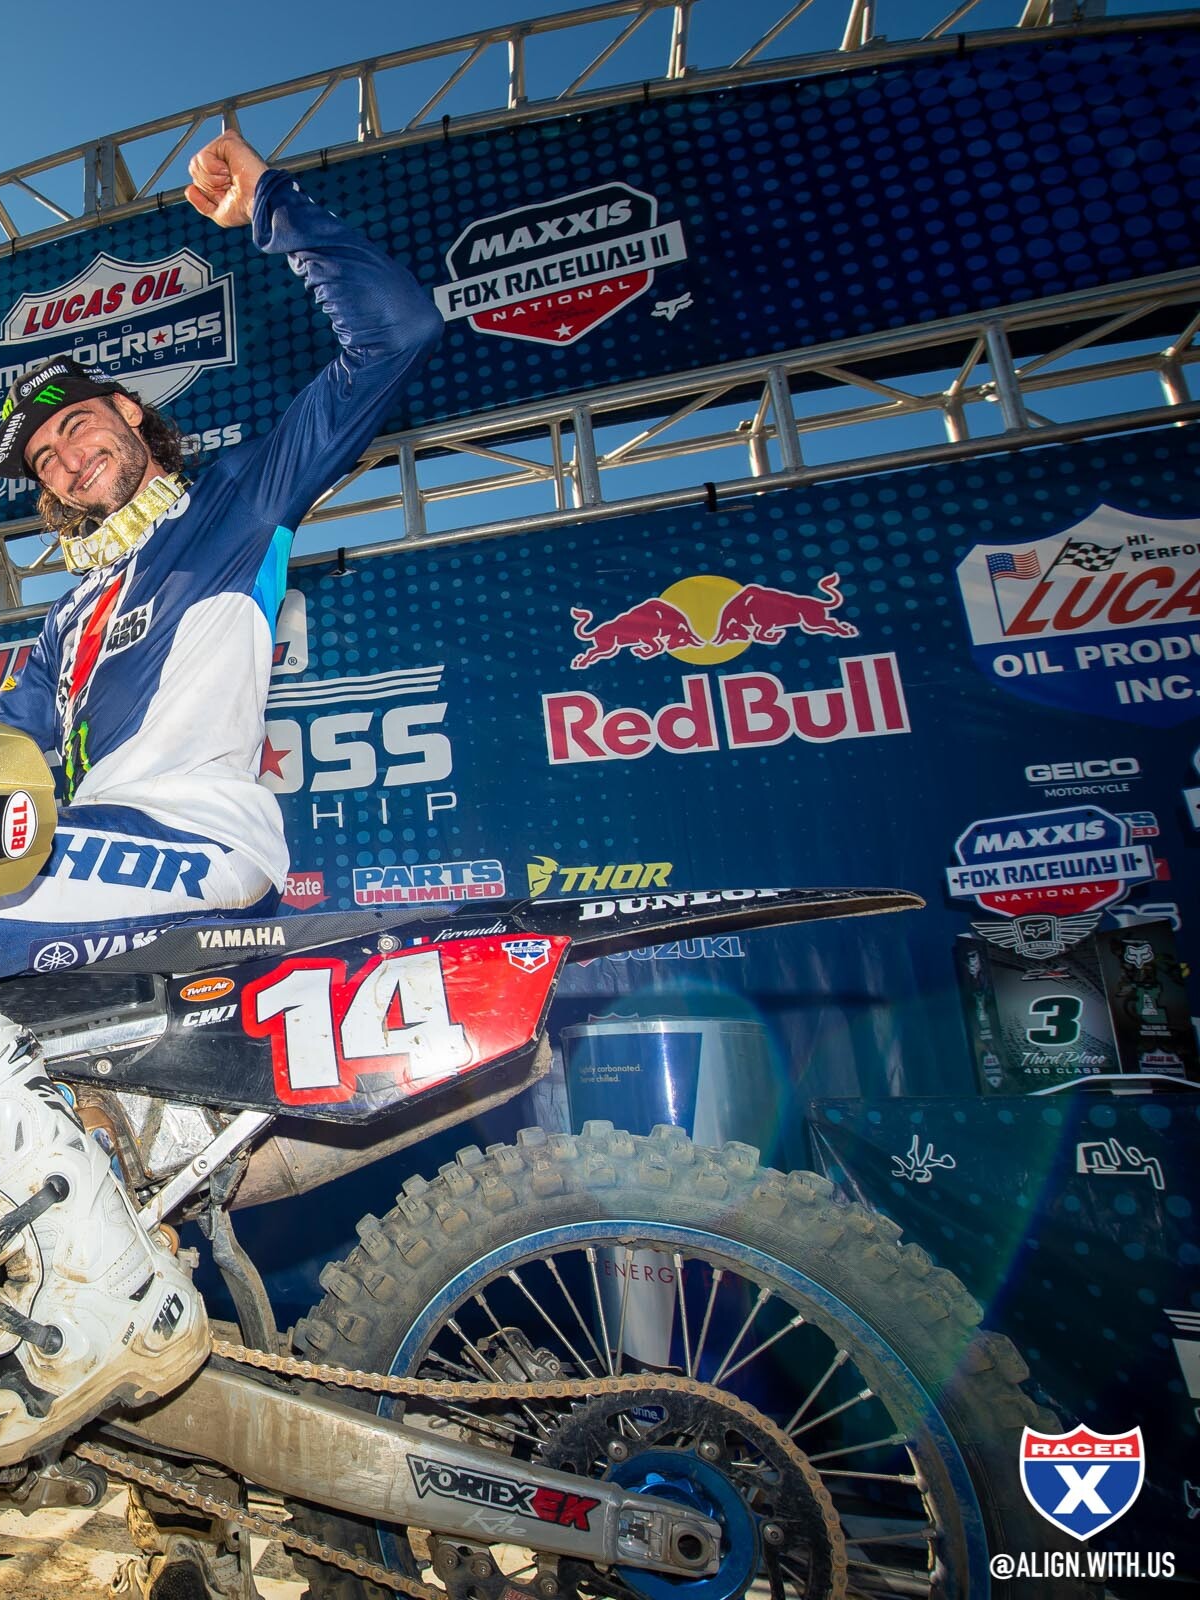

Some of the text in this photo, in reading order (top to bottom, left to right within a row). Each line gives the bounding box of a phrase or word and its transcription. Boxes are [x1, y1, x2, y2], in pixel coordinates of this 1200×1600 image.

[469, 199, 632, 265] MAXXIS
[448, 276, 502, 313] FOX
[505, 238, 646, 298] RACEWAY
[23, 267, 185, 336] LUCAS OIL
[491, 280, 631, 322] NATIONAL
[75, 325, 132, 346] PRO
[30, 364, 68, 388] YAMAHA
[1126, 535, 1154, 547] HI-
[1004, 567, 1200, 636] LUCA
[993, 651, 1064, 677] OIL
[543, 674, 718, 764] Red
[719, 653, 910, 749] Bull
[1025, 758, 1140, 782] GEICO
[1044, 783, 1130, 798] MOTORCYCLE
[11, 801, 28, 850] BELL
[973, 820, 1106, 854] MAXXIS
[39, 832, 211, 900] HOR
[354, 860, 503, 890] PARTS
[558, 862, 674, 892] THOR
[958, 868, 1000, 890] FOX
[1004, 855, 1117, 884] RACEWAY
[285, 877, 321, 897] Rate
[356, 883, 504, 904] UNLIMITED
[994, 885, 1105, 903] NATIONAL
[579, 888, 790, 921] DUNLOP
[198, 926, 286, 948] YAMAHA
[433, 918, 508, 943] Ferrandis
[186, 981, 230, 996] Twin Air
[256, 950, 466, 1090] 14
[1026, 994, 1084, 1047] 3
[1021, 1051, 1108, 1067] Third Place
[604, 1259, 675, 1284] ENERG
[409, 1455, 600, 1531] VORTEX EK
